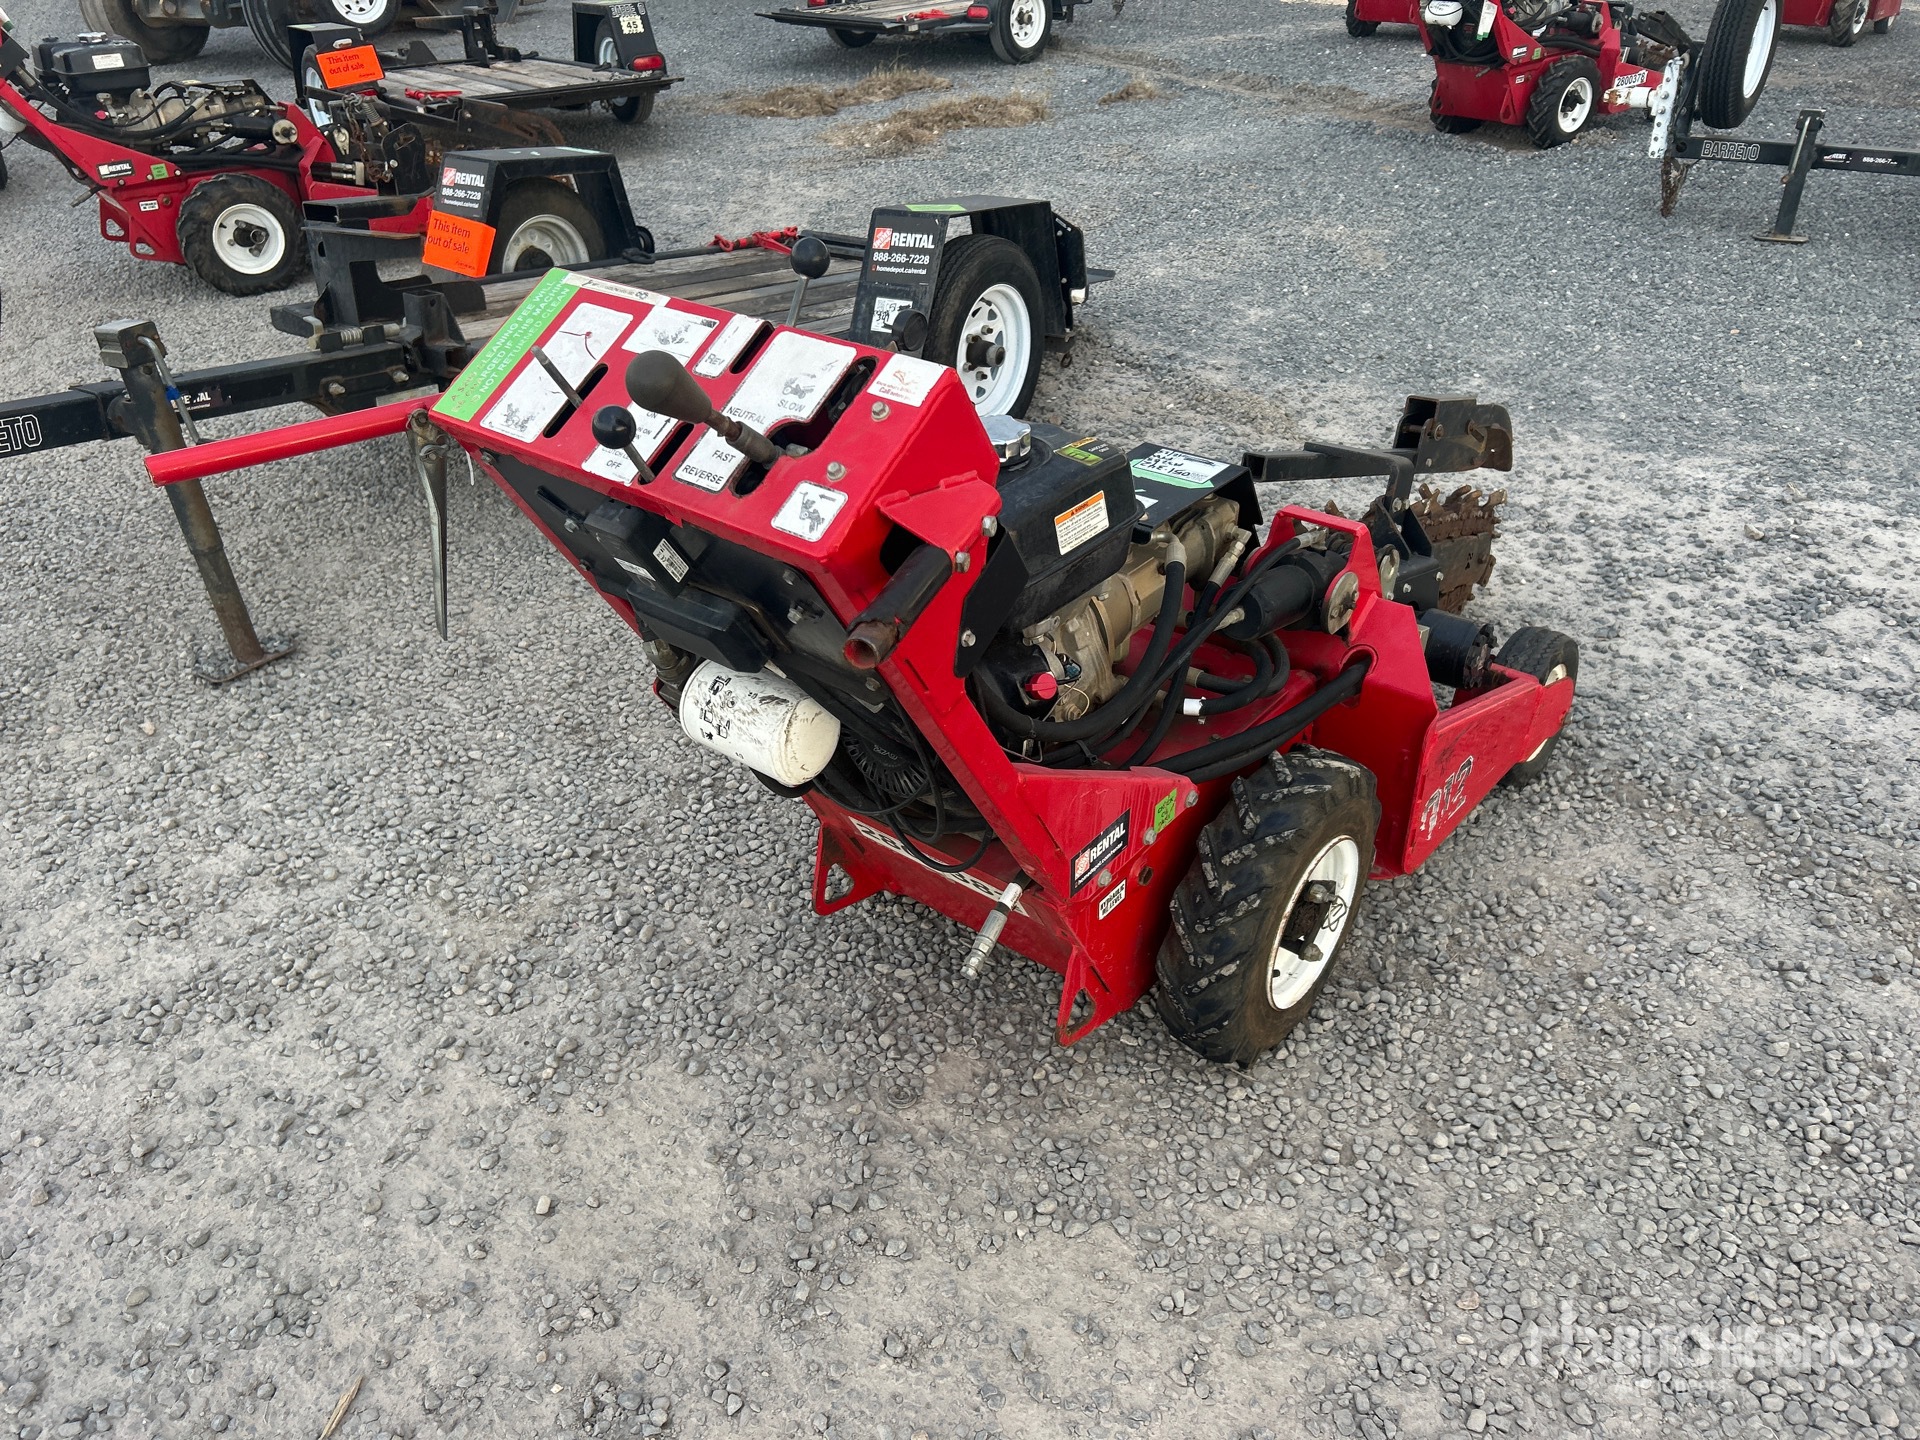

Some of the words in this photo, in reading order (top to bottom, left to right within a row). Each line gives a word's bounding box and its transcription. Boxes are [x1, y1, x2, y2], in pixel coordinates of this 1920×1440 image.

[626, 21, 639, 29] 45
[326, 56, 342, 65] This
[343, 54, 360, 62] item
[329, 67, 342, 75] out
[342, 64, 350, 72] of
[351, 62, 365, 71] sale
[1701, 140, 1760, 161] BARRETO
[1862, 156, 1898, 165] 888-266-7
[454, 172, 485, 188] RENTAL
[442, 186, 481, 201] 888-266-7228
[434, 218, 450, 233] This
[451, 223, 471, 239] item
[427, 234, 442, 248] out
[442, 238, 453, 250] of
[453, 241, 470, 255] sale
[891, 232, 935, 249] RENTAL
[873, 251, 930, 265] 888-266-7228
[477, 323, 519, 369] CLEANING
[519, 303, 535, 322] FEE
[533, 280, 555, 302] WILL
[479, 372, 499, 393] NOT
[498, 320, 543, 371] RETURNED
[541, 288, 571, 319] CLEAN
[504, 340, 513, 350] IF
[513, 318, 534, 339] THIS
[777, 399, 806, 413] SLOW
[726, 406, 767, 425] NEUTRAL
[711, 450, 737, 463] FAST
[606, 460, 622, 470] OFF
[682, 465, 725, 485] REVERSE
[1090, 822, 1126, 863] RENTAL
